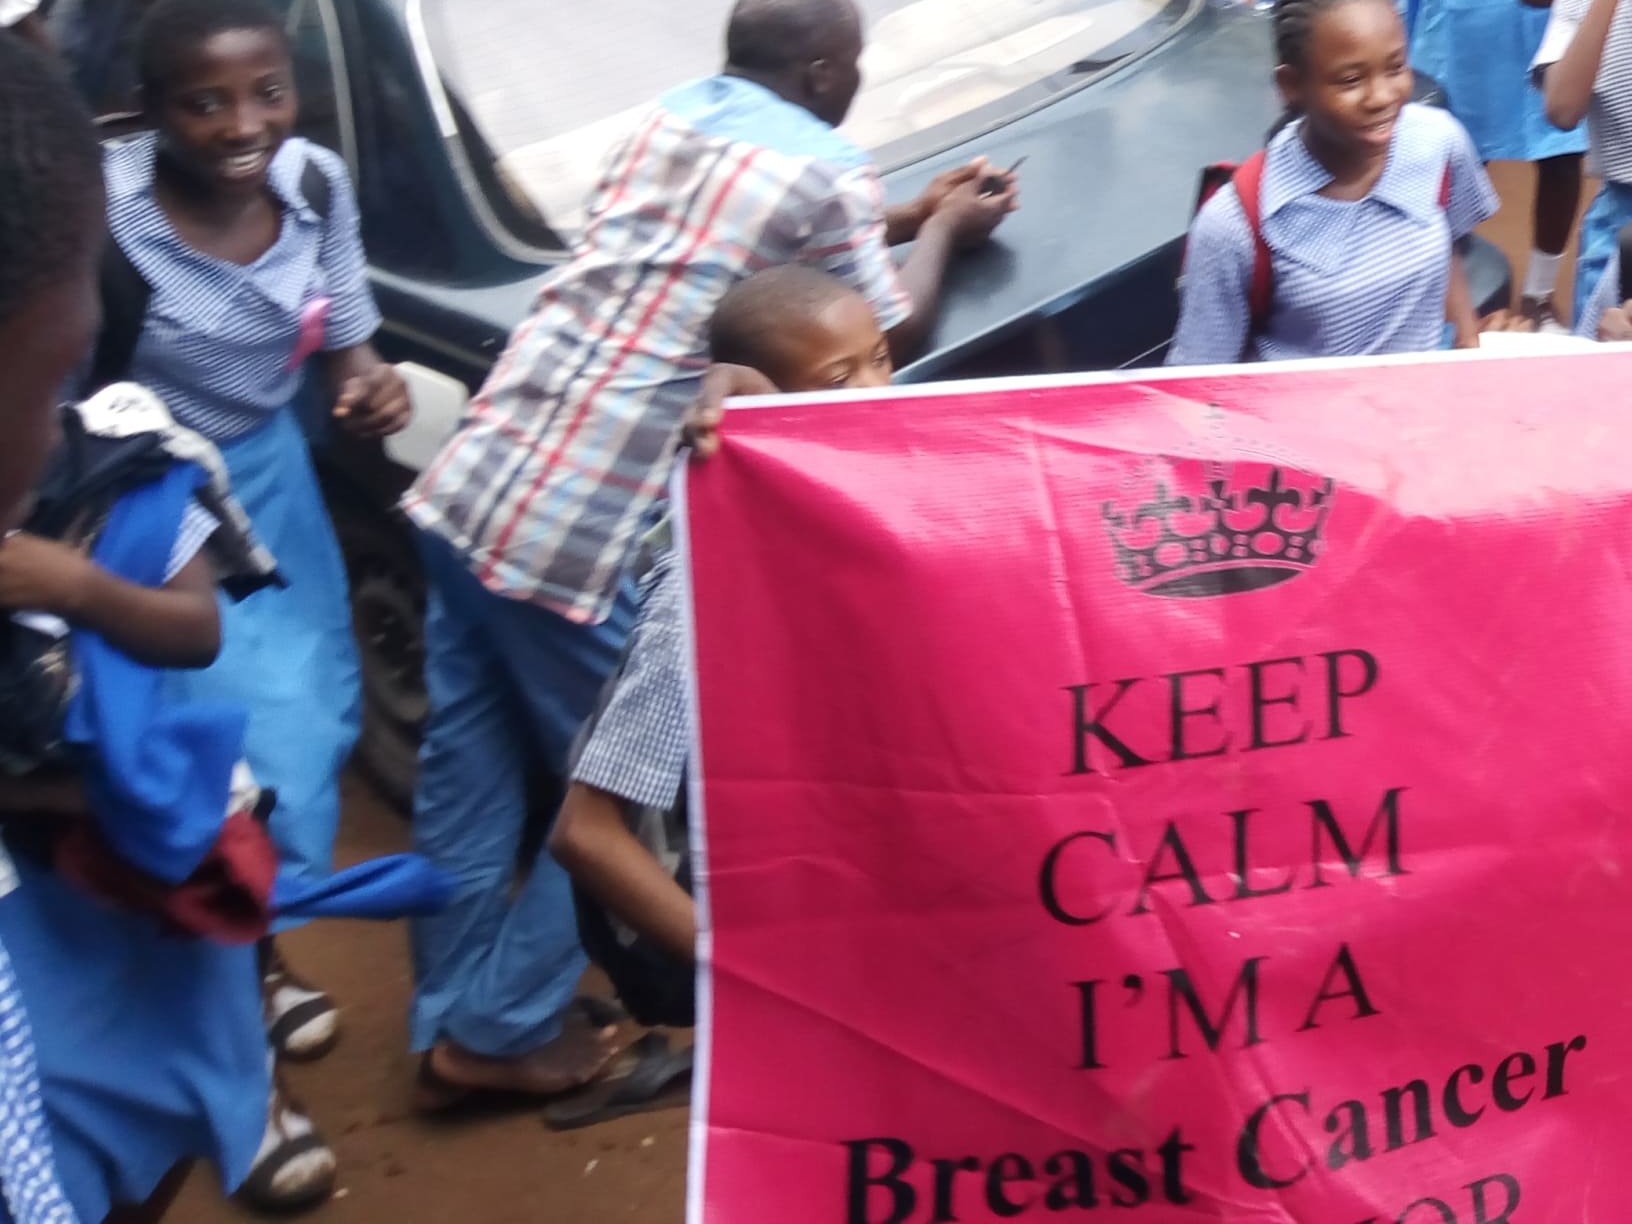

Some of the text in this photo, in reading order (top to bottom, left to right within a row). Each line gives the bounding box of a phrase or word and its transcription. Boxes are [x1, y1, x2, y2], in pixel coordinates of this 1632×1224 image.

[1061, 648, 1379, 777] KEEP
[1038, 787, 1412, 927] CALM
[1295, 941, 1382, 1033] A
[841, 1033, 1588, 1224] Breast Cancer
